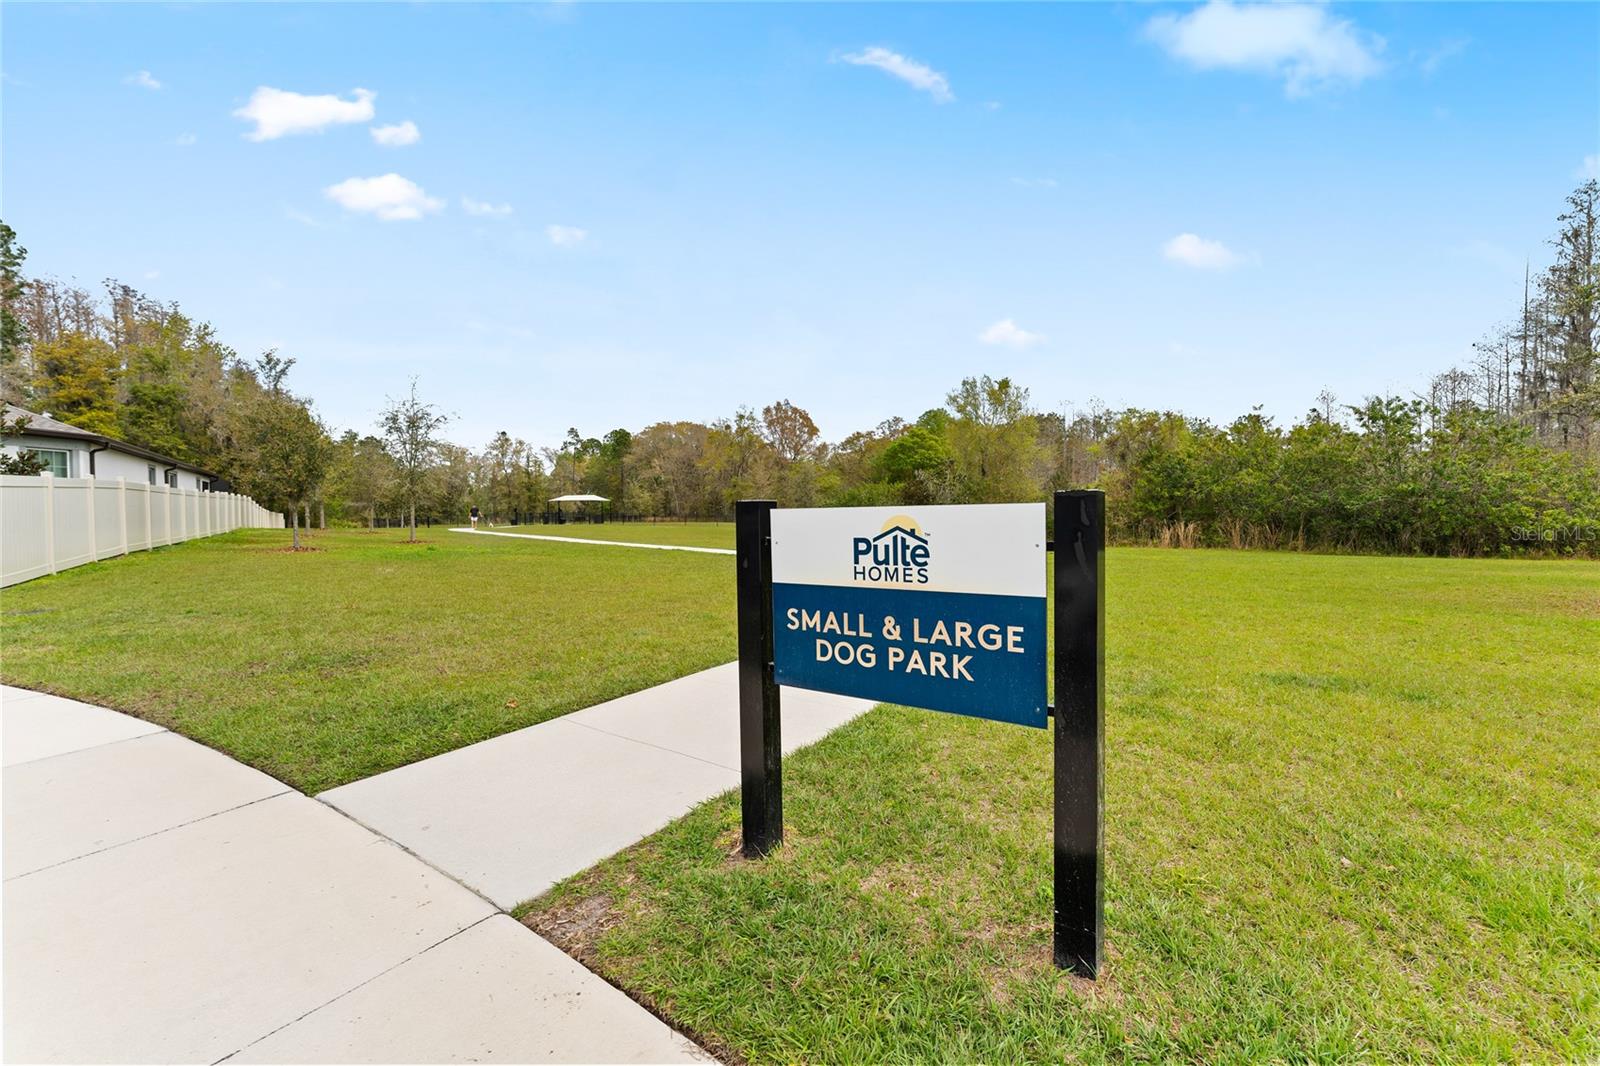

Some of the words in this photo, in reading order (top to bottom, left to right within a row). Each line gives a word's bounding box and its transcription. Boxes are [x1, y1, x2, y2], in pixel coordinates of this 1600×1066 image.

[853, 534, 930, 567] Pulte
[853, 566, 929, 584] HOMES
[786, 608, 873, 638] SMALL
[882, 615, 902, 641] &
[913, 618, 1025, 654] LARGE
[815, 638, 877, 668] DOG
[888, 646, 975, 682] PARK
